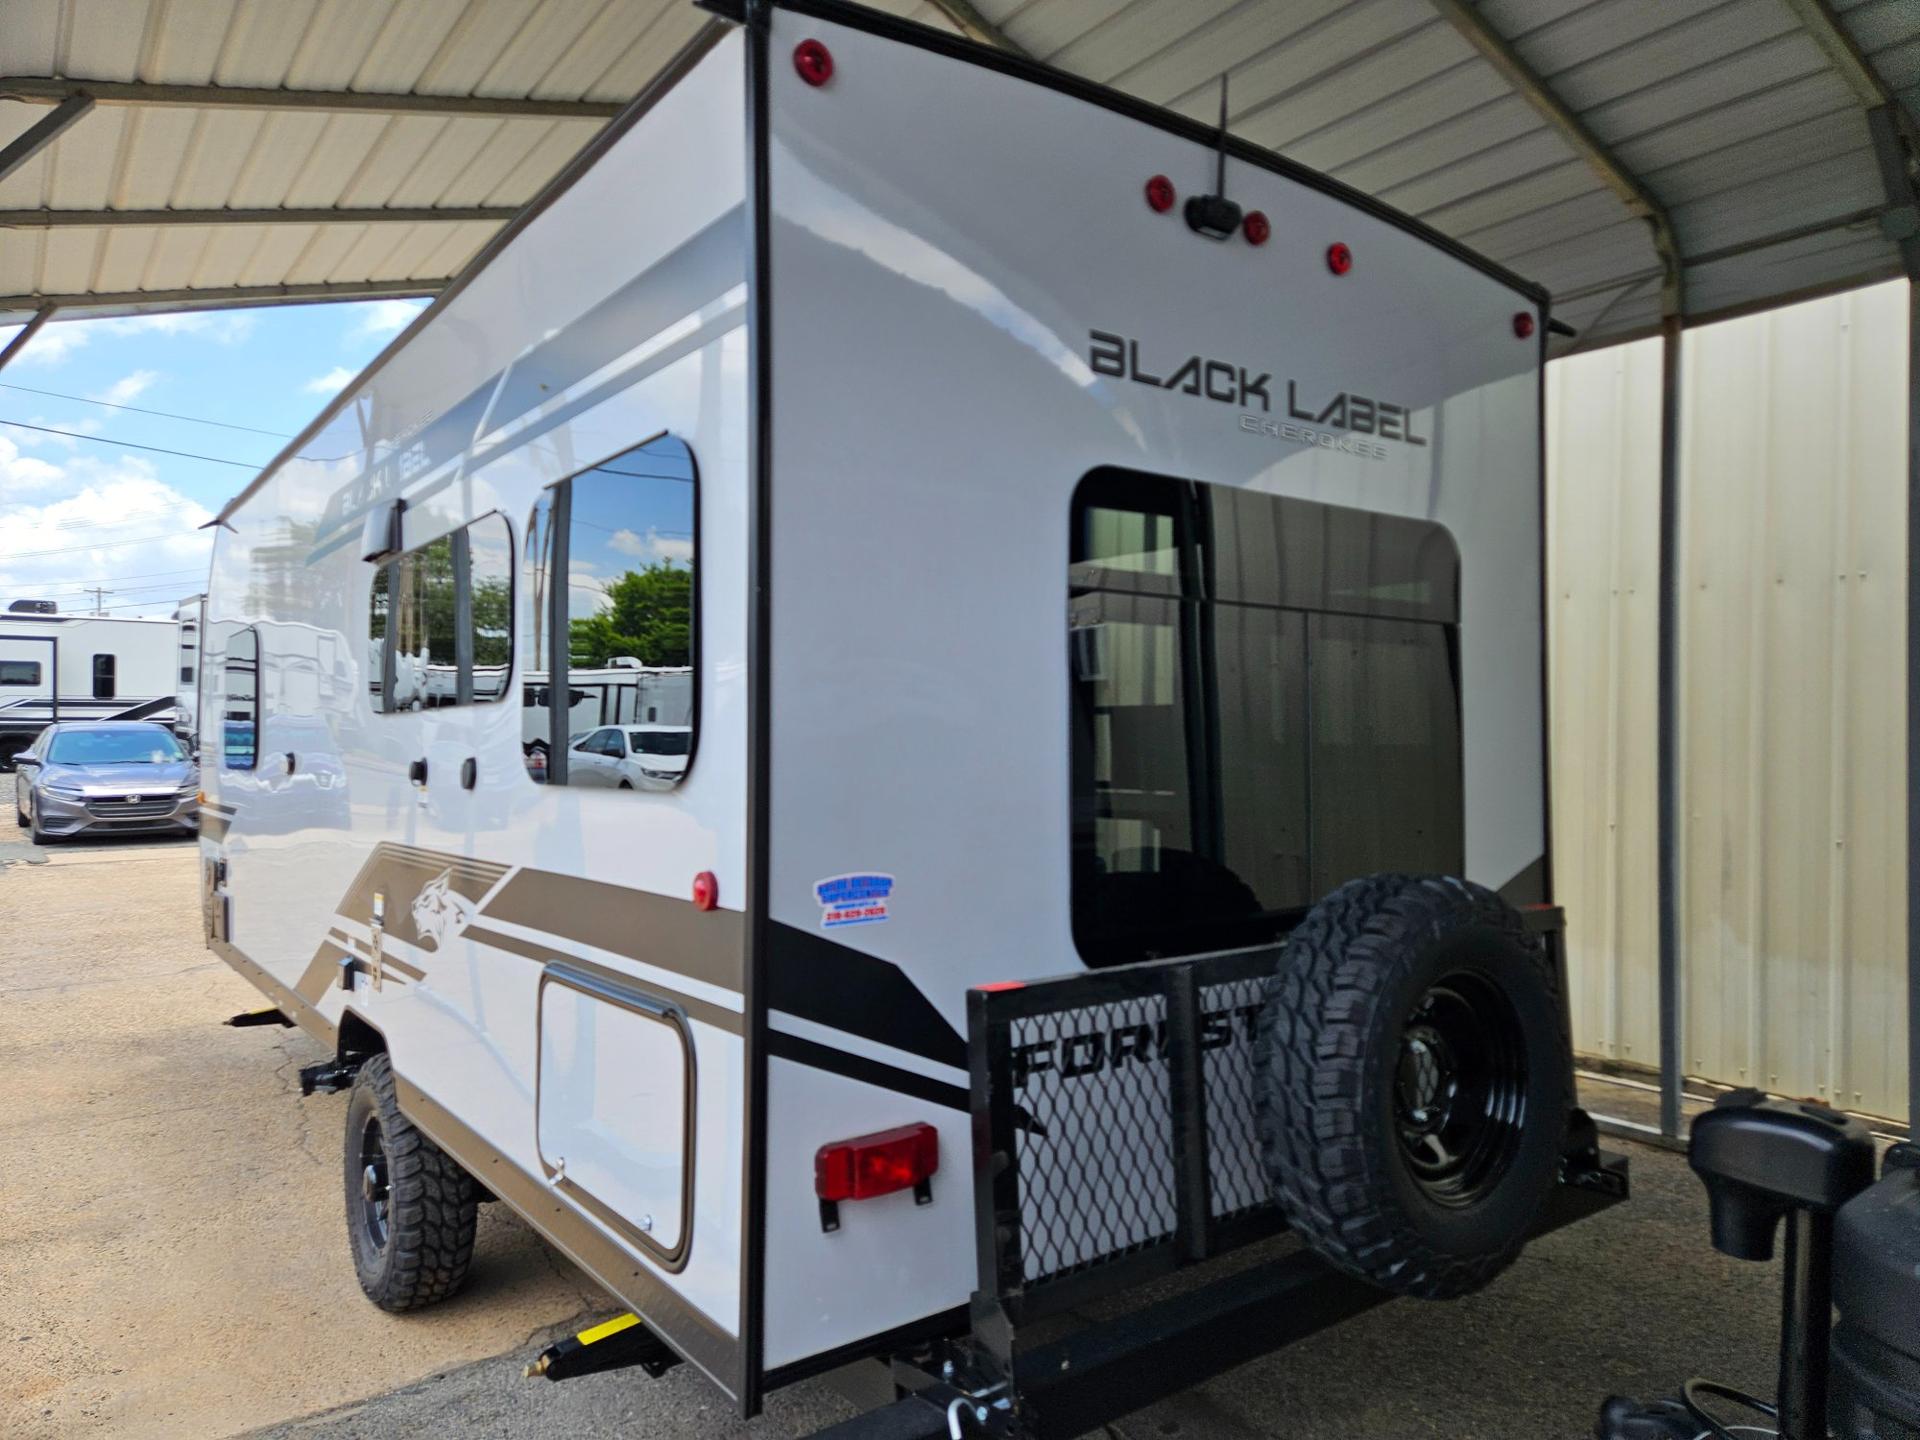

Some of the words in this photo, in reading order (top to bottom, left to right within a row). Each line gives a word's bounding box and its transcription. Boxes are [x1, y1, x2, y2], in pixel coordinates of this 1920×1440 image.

[1089, 328, 1271, 412] BLACK
[1287, 379, 1427, 446] LABEL
[1239, 414, 1391, 460] CHEROKEE
[1012, 1002, 1266, 1088] FORST
